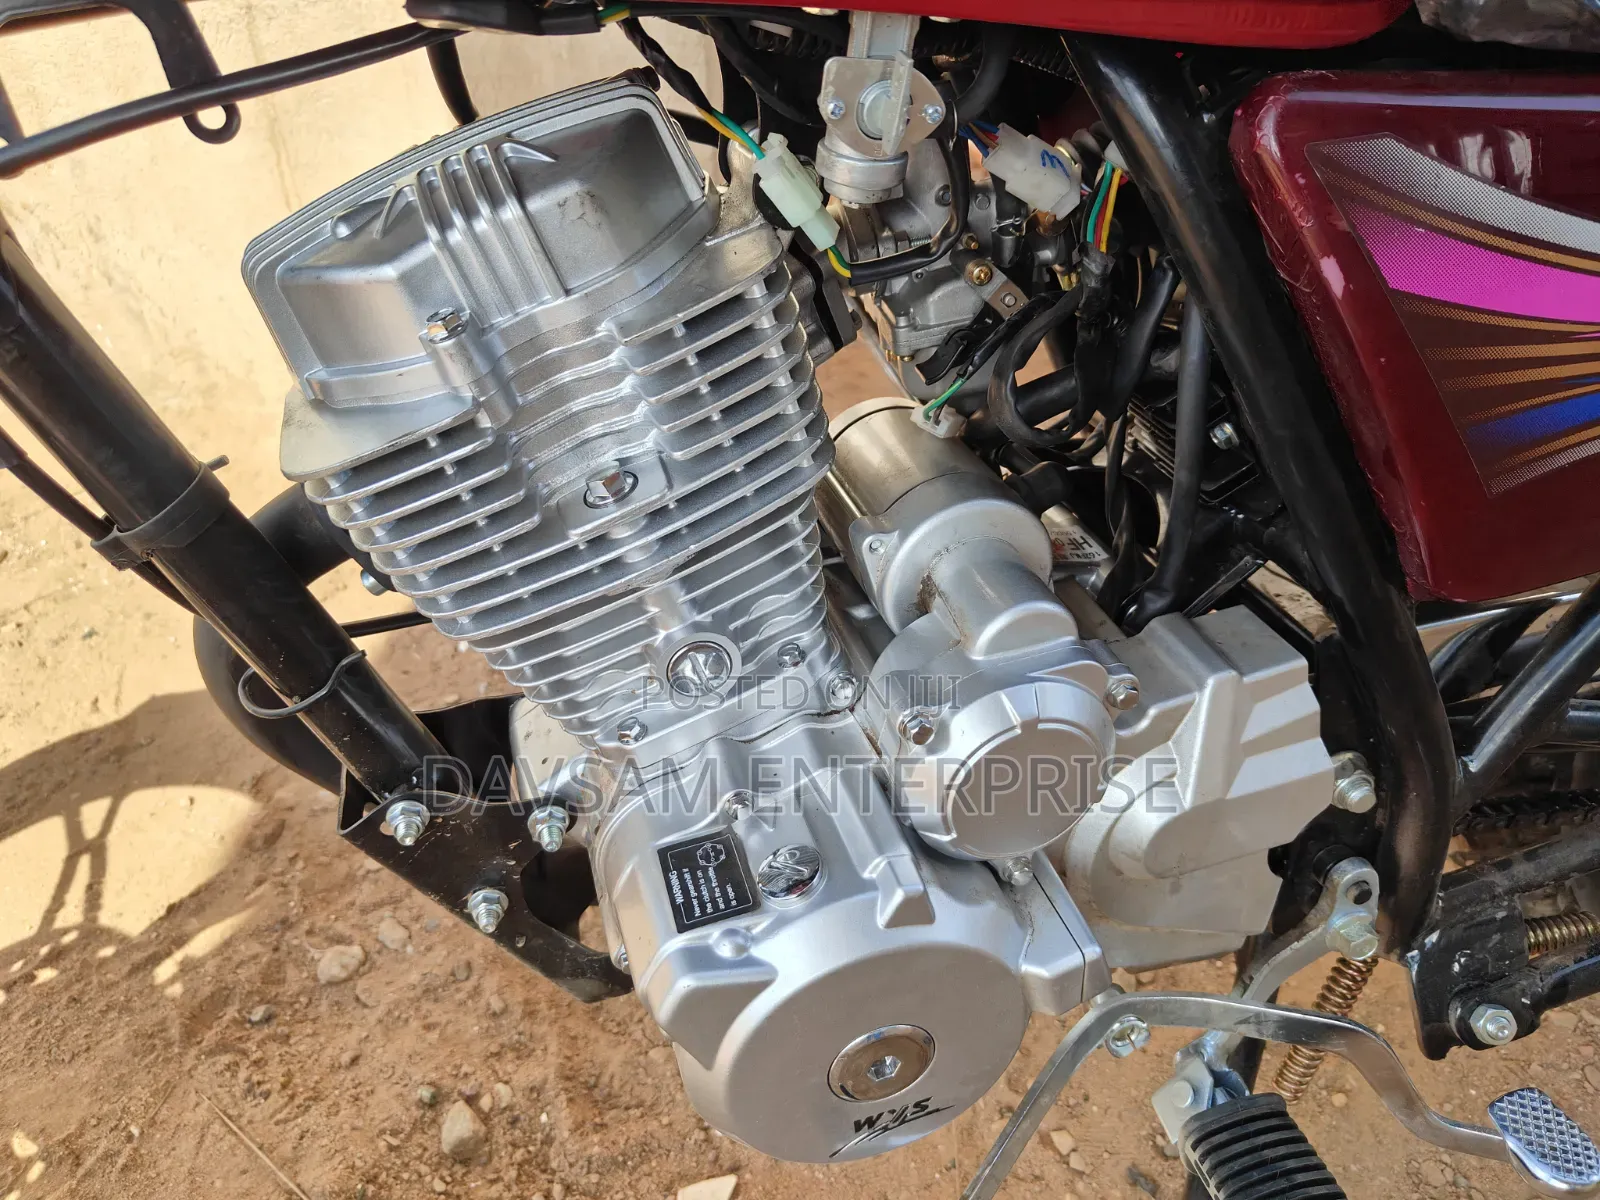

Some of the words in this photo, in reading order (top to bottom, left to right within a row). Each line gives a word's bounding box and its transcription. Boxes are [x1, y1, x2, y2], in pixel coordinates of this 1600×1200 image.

[696, 869, 703, 878] on
[707, 866, 718, 887] throttle
[669, 871, 684, 904] WARNING
[683, 873, 698, 897] gearshift
[699, 884, 710, 903] clutch
[714, 887, 722, 898] the
[691, 898, 702, 917] Never
[705, 902, 714, 913] the
[716, 897, 725, 910] and
